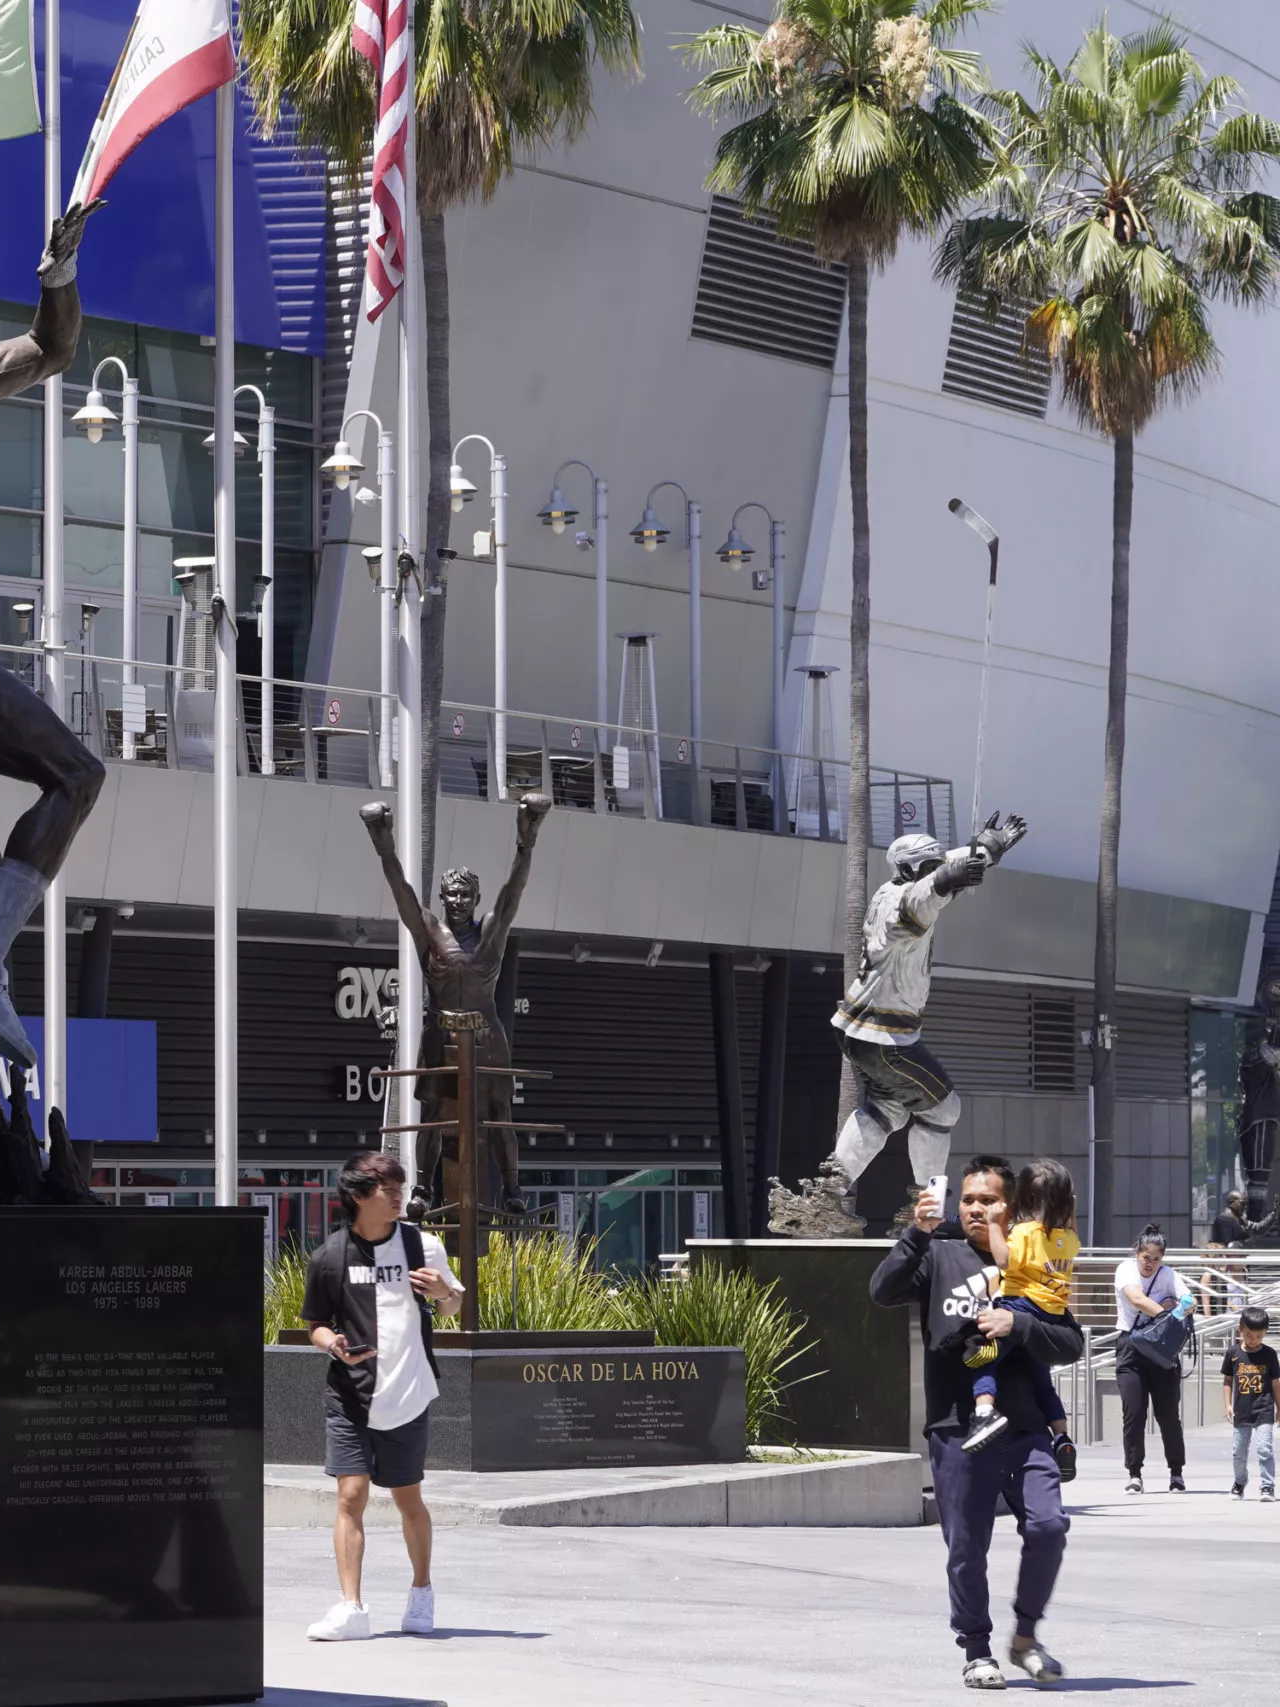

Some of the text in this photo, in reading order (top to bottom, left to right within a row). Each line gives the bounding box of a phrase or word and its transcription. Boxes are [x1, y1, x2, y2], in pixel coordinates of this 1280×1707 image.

[127, 1173, 134, 1185] 5
[180, 1171, 187, 1184] 6
[542, 1172, 551, 1185] 13
[59, 1265, 193, 1278] KAREEM ABDUL-JABBAR
[348, 1264, 402, 1284] WHAT?
[66, 1281, 186, 1294] LOS ANGELES LAKERS
[93, 1297, 118, 1309] 1975
[135, 1296, 160, 1309] 1989
[45, 1353, 59, 1361] THE
[84, 1352, 101, 1361] ONLY
[25, 1369, 35, 1378] AS
[37, 1369, 54, 1377] WELL
[56, 1369, 65, 1377] AS
[194, 1368, 205, 1376] ALL
[522, 1361, 700, 1383] OSCAR DE LA HOYA
[36, 1385, 62, 1393] ROOKIE
[1238, 1374, 1263, 1394] 24
[64, 1401, 79, 1409] FIVE
[101, 1400, 114, 1408] THE
[147, 1399, 175, 1408] KAREEM
[108, 1415, 122, 1424] THE
[199, 1414, 228, 1423] PLAYERS
[13, 1433, 32, 1441] WHO
[34, 1433, 51, 1441] EVER
[132, 1431, 147, 1439] WHO
[75, 1448, 101, 1456] CAREER
[103, 1448, 112, 1456] AS
[114, 1447, 128, 1455] THE
[12, 1465, 40, 1474] SCORER
[41, 1465, 59, 1474] WITH
[19, 1481, 31, 1489] HIS
[33, 1480, 63, 1489] ELEGANT
[65, 1479, 81, 1488] AND
[167, 1477, 181, 1486] ONE
[184, 1476, 193, 1485] OF
[195, 1476, 209, 1485] THE
[5, 1496, 49, 1506] ATHLETICALLY
[153, 1494, 166, 1502] THE
[167, 1493, 186, 1502] GAME
[189, 1493, 203, 1501] HAS
